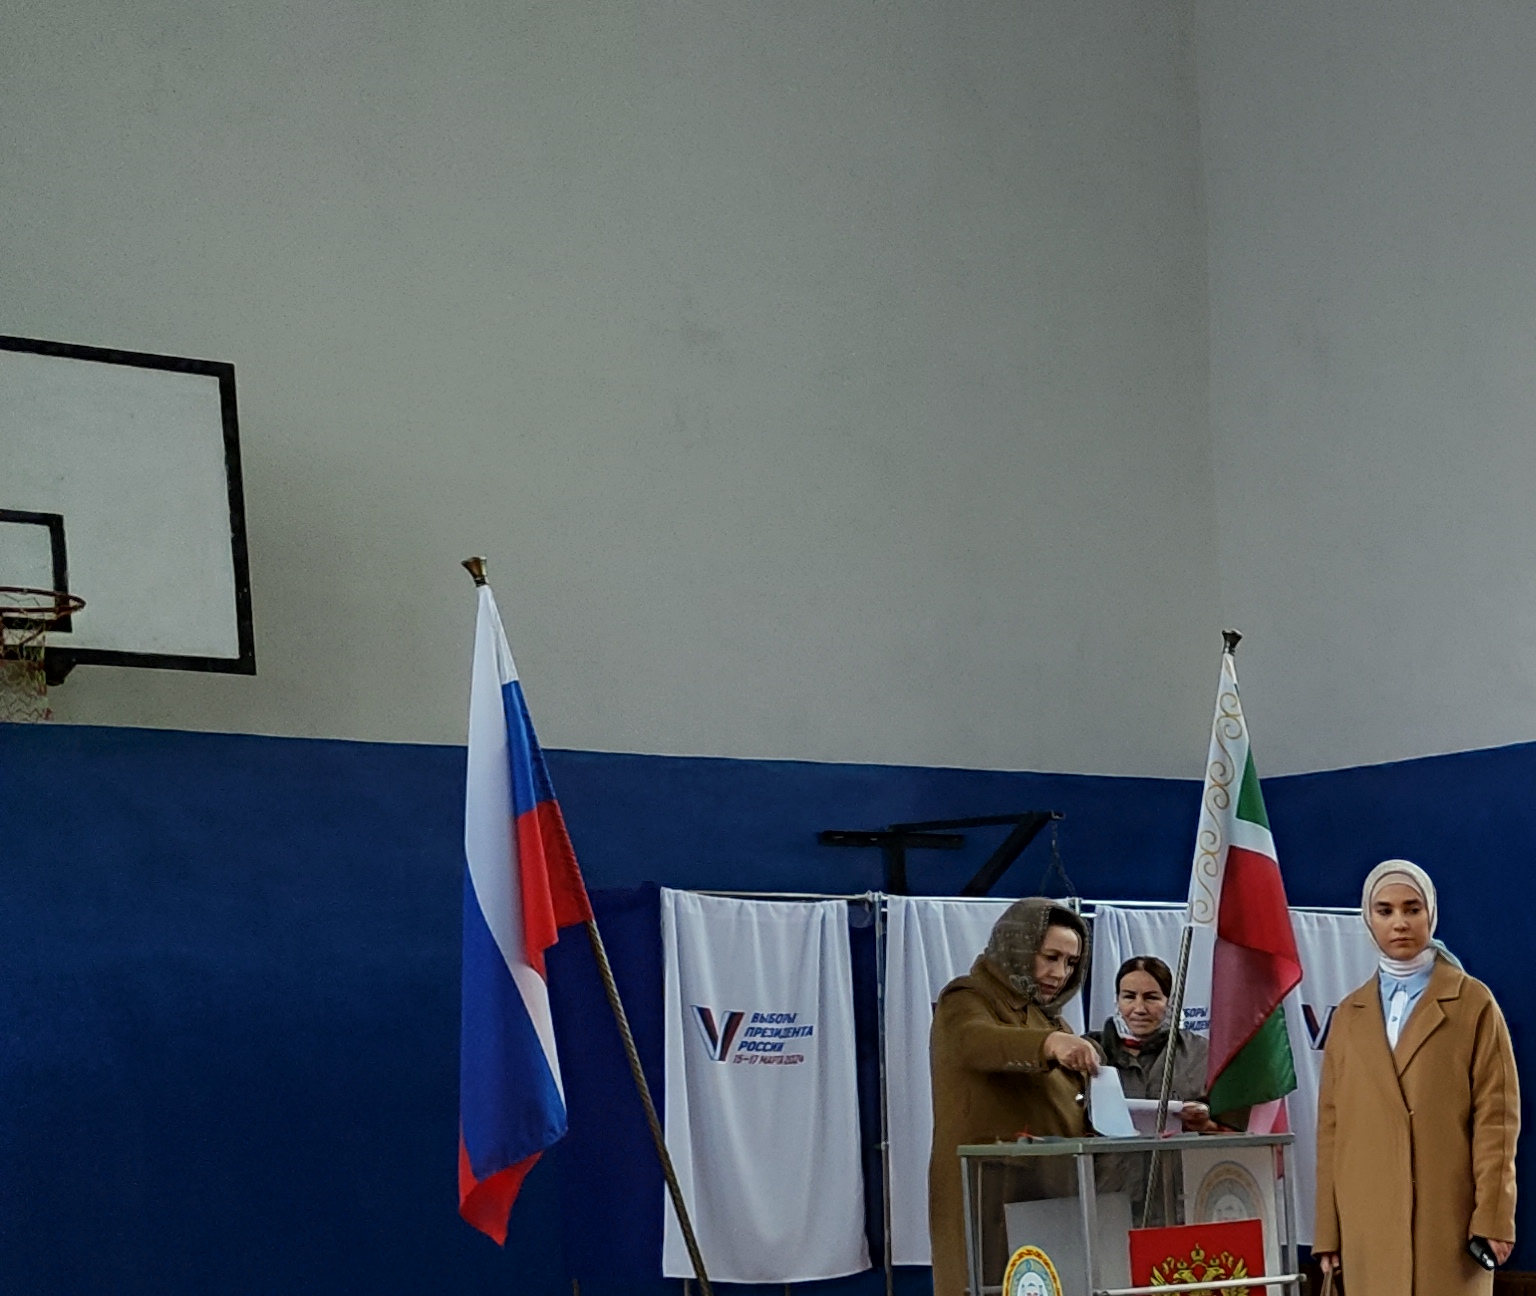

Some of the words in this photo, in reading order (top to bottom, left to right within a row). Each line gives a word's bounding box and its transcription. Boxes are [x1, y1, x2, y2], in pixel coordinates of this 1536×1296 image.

[750, 1012, 797, 1024] ВЫБОРЫ
[743, 1025, 814, 1039] ПРЕЗИДЕНТА
[738, 1040, 785, 1052] РОССИИ
